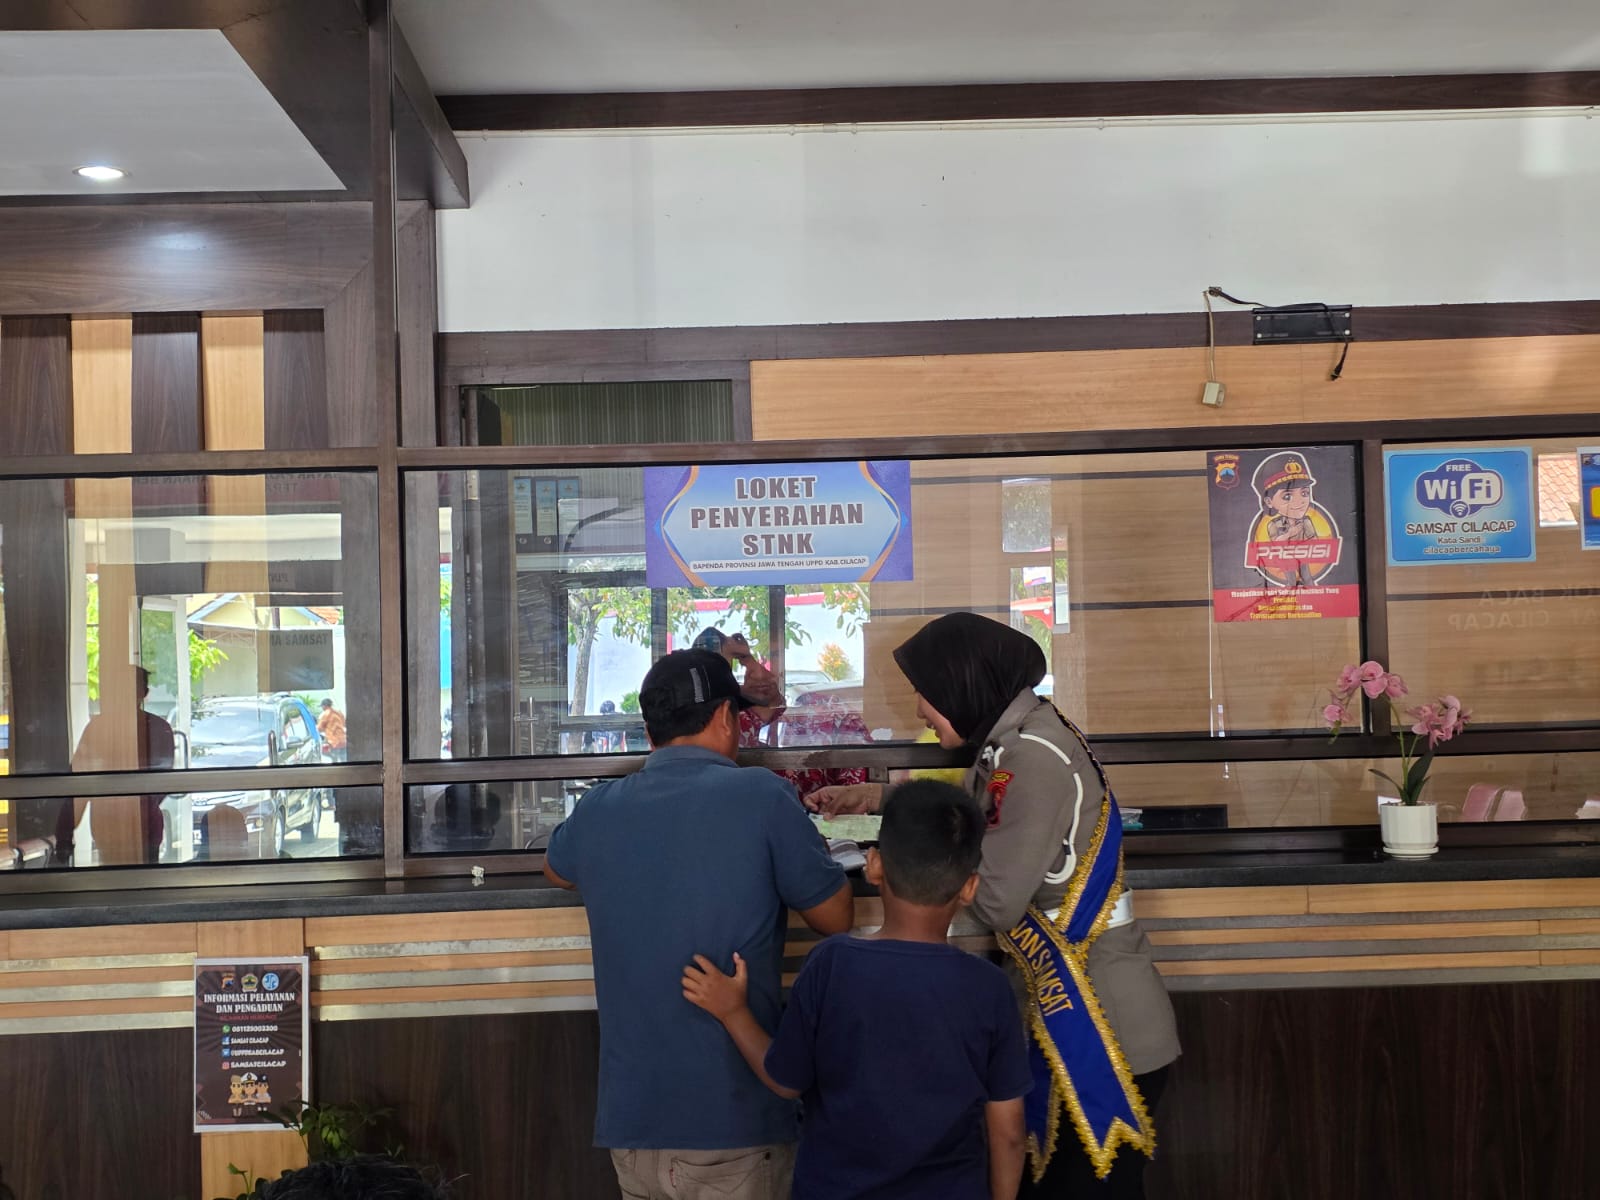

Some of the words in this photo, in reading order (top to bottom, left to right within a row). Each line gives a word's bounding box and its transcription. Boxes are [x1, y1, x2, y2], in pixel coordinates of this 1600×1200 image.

[1446, 464, 1472, 472] FREE
[736, 476, 816, 500] LOKET
[691, 503, 864, 529] PENYERAHAN
[1406, 523, 1457, 534] SAMSAT
[1461, 521, 1515, 533] CILACAP
[743, 533, 814, 556] STNK
[1438, 536, 1457, 544] Kata
[1459, 536, 1481, 544] Sandi
[1256, 544, 1330, 560] PRESISI
[693, 562, 724, 570] BAPENDA
[204, 993, 248, 1003] INFORMASI
[250, 992, 295, 1002] PELAYANAN
[216, 1004, 233, 1013] DAN
[235, 1003, 283, 1013] PENGADUAN
